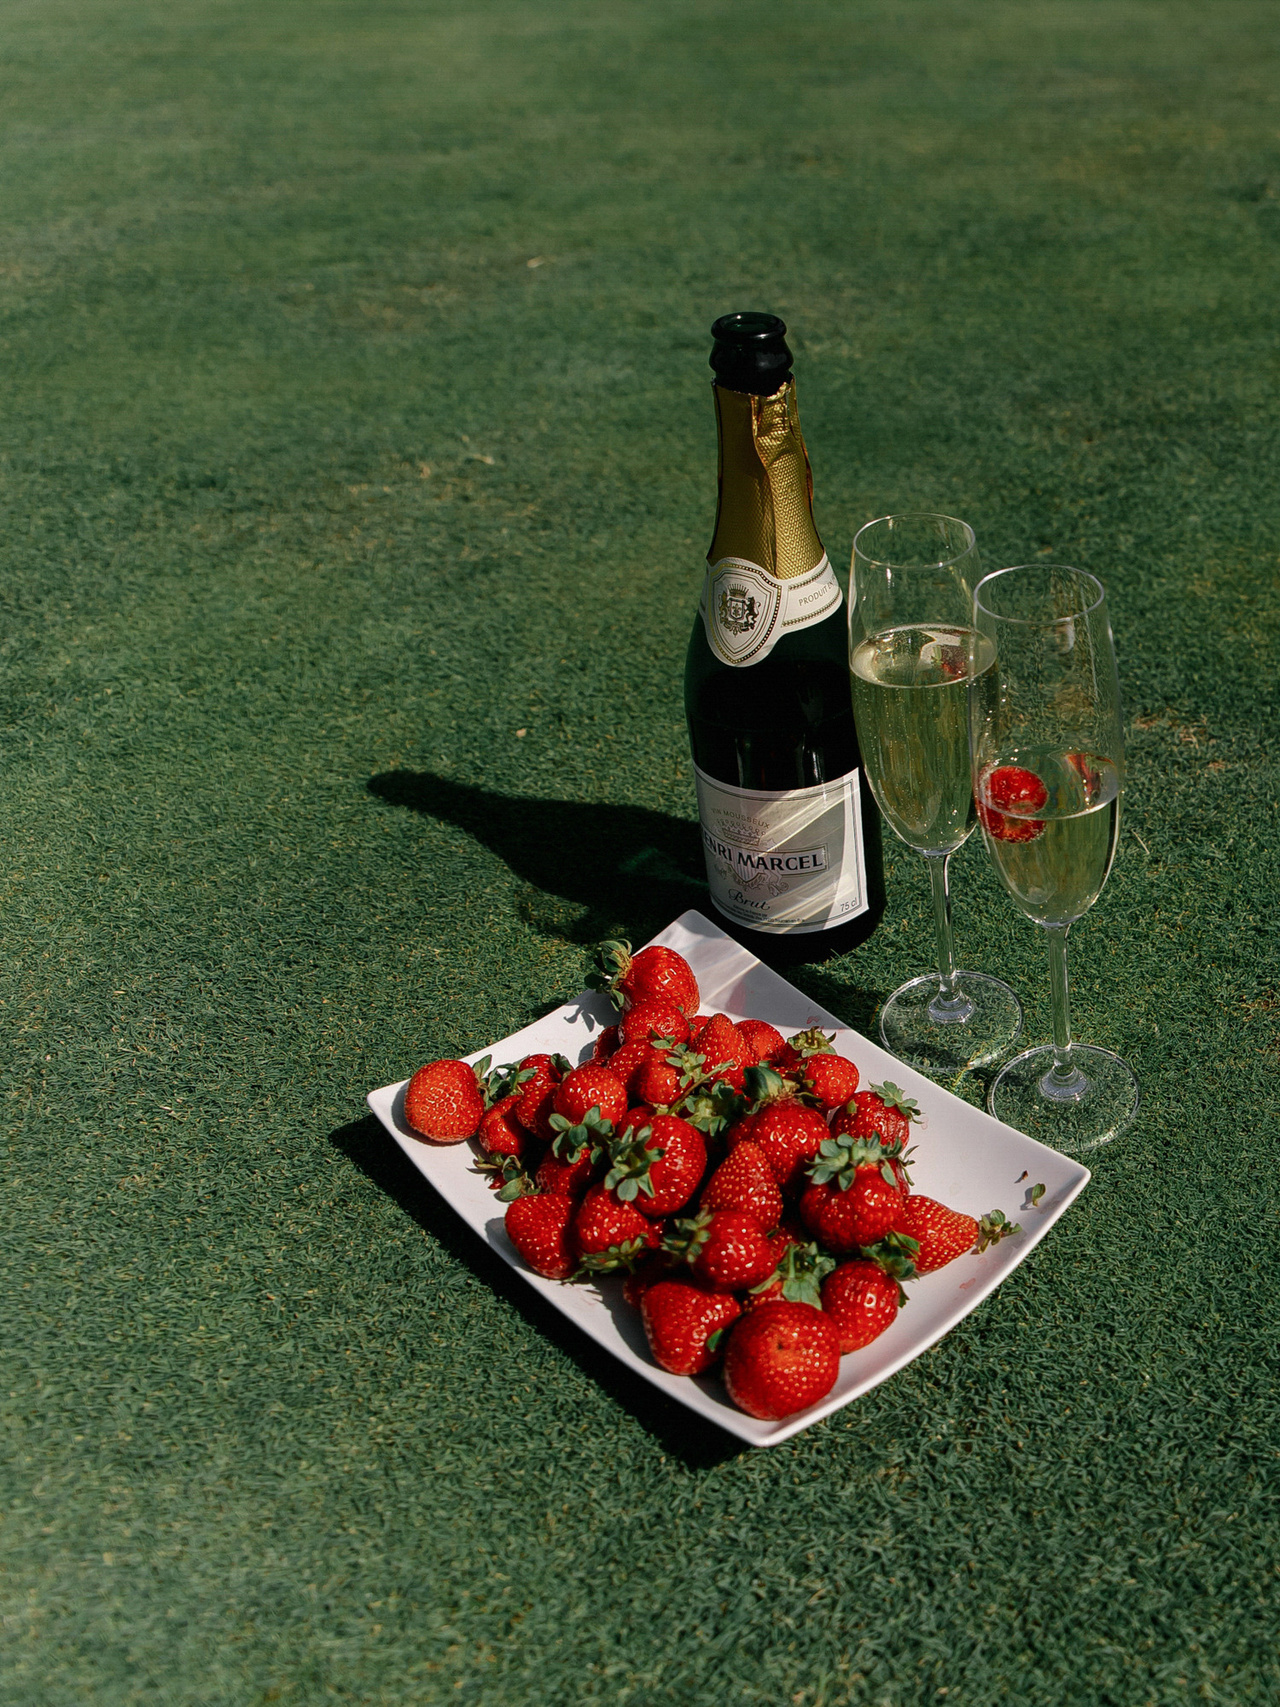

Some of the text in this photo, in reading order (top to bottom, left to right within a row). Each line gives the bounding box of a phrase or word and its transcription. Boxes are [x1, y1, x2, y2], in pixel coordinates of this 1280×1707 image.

[798, 585, 828, 607] PRODUIT
[723, 810, 771, 829] MOUSSEUX
[703, 830, 823, 871] ENRI MARCEL
[728, 888, 771, 911] Brut
[840, 902, 850, 912] 75
